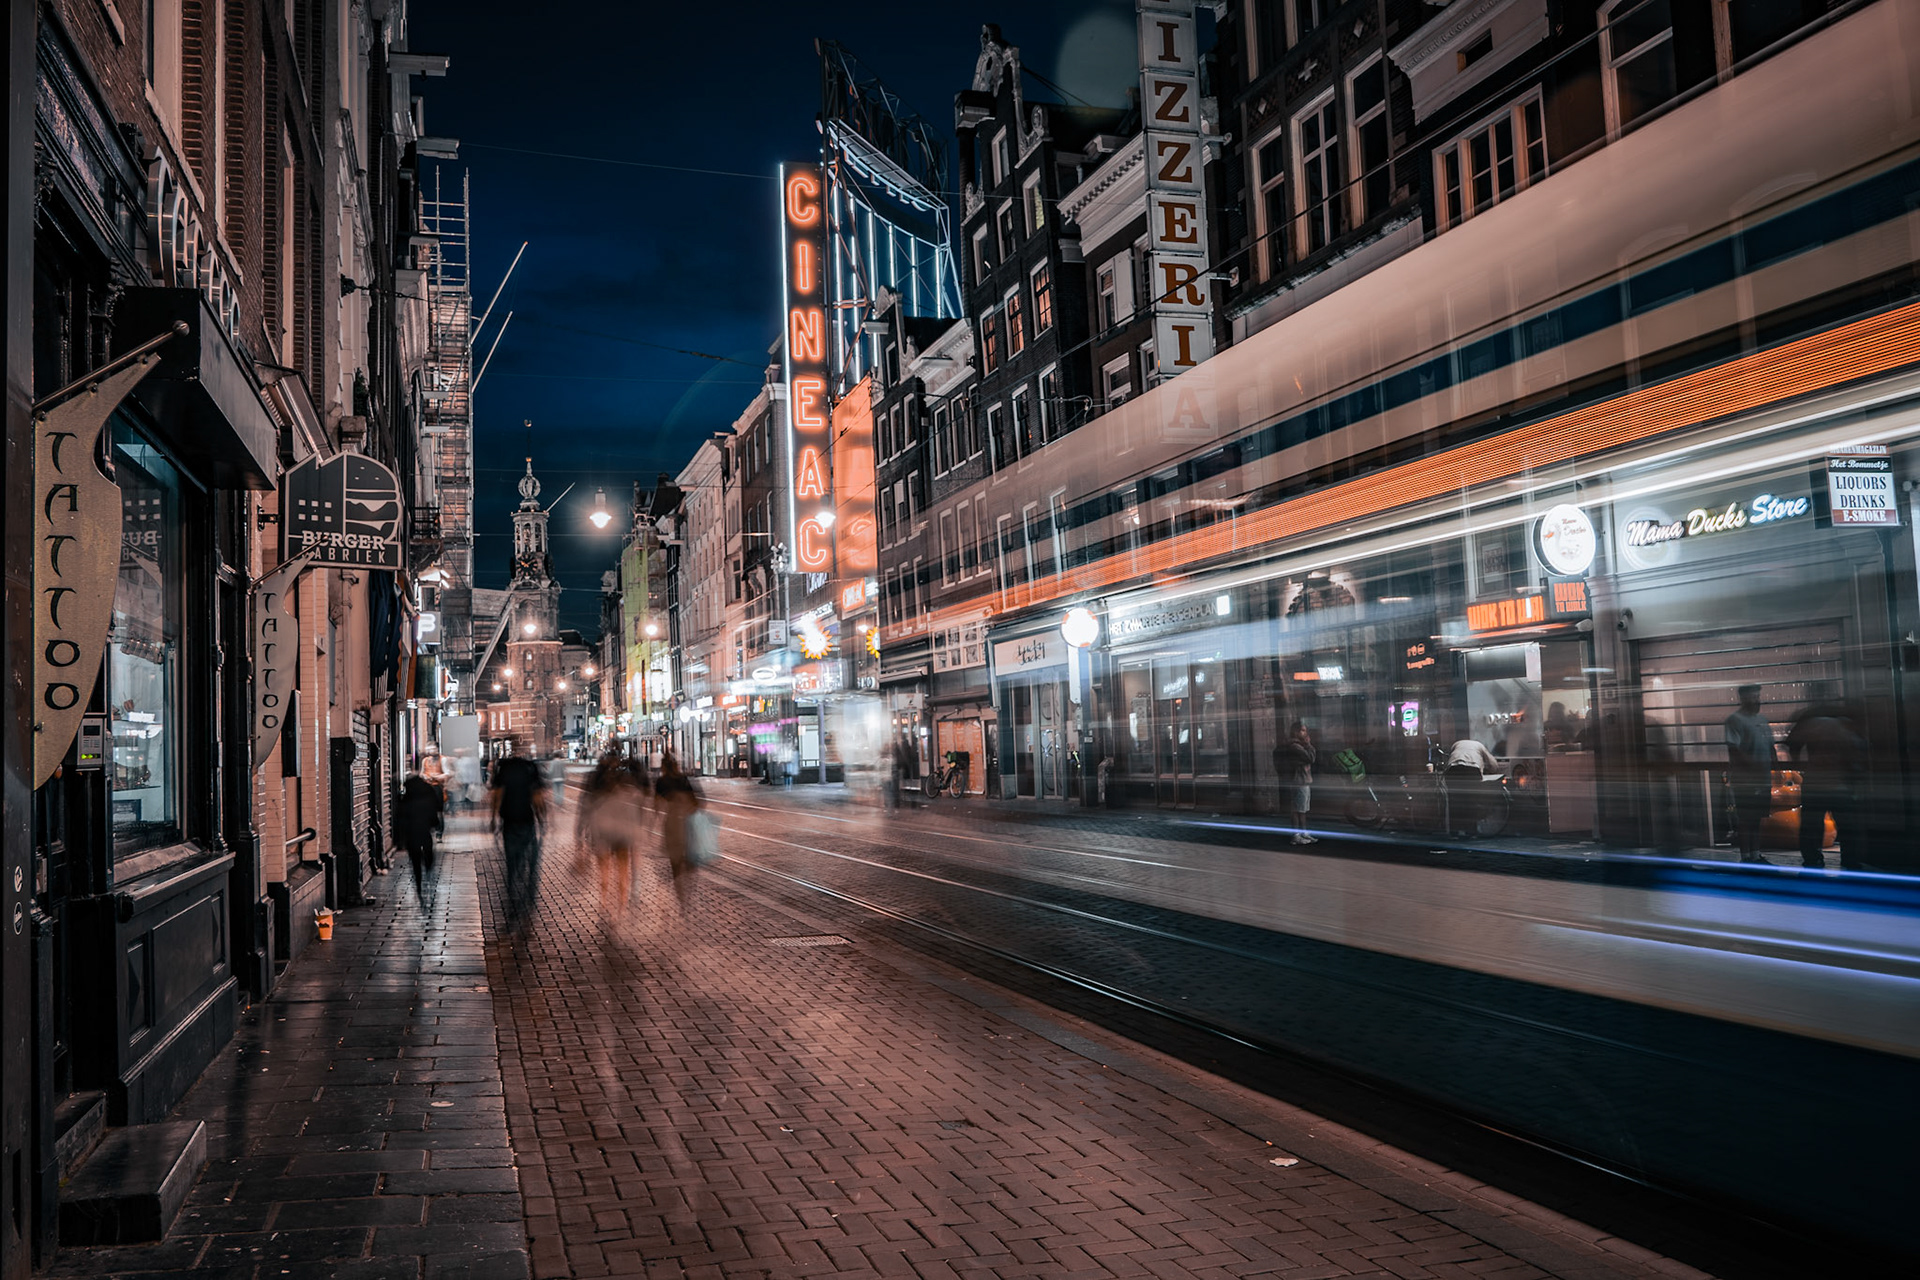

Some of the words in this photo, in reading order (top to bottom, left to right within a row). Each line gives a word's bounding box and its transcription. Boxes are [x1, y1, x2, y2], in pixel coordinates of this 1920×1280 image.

[1153, 0, 1210, 429] IZZERIA
[787, 176, 827, 567] CINEAC
[1830, 459, 1846, 468] Het
[1835, 476, 1887, 490] LIQUORS
[1840, 494, 1886, 508] DRINKS
[1627, 519, 1685, 547] Mama
[1686, 501, 1748, 537] Ducks
[1749, 493, 1809, 525] Store
[1843, 510, 1887, 522] E-SMOKE
[302, 530, 385, 550] BURGER
[44, 432, 81, 712] TATTOO
[1553, 582, 1586, 602] WOK
[1467, 603, 1498, 631] WOK
[1498, 600, 1516, 627] TO
[262, 592, 279, 729] TATTOO
